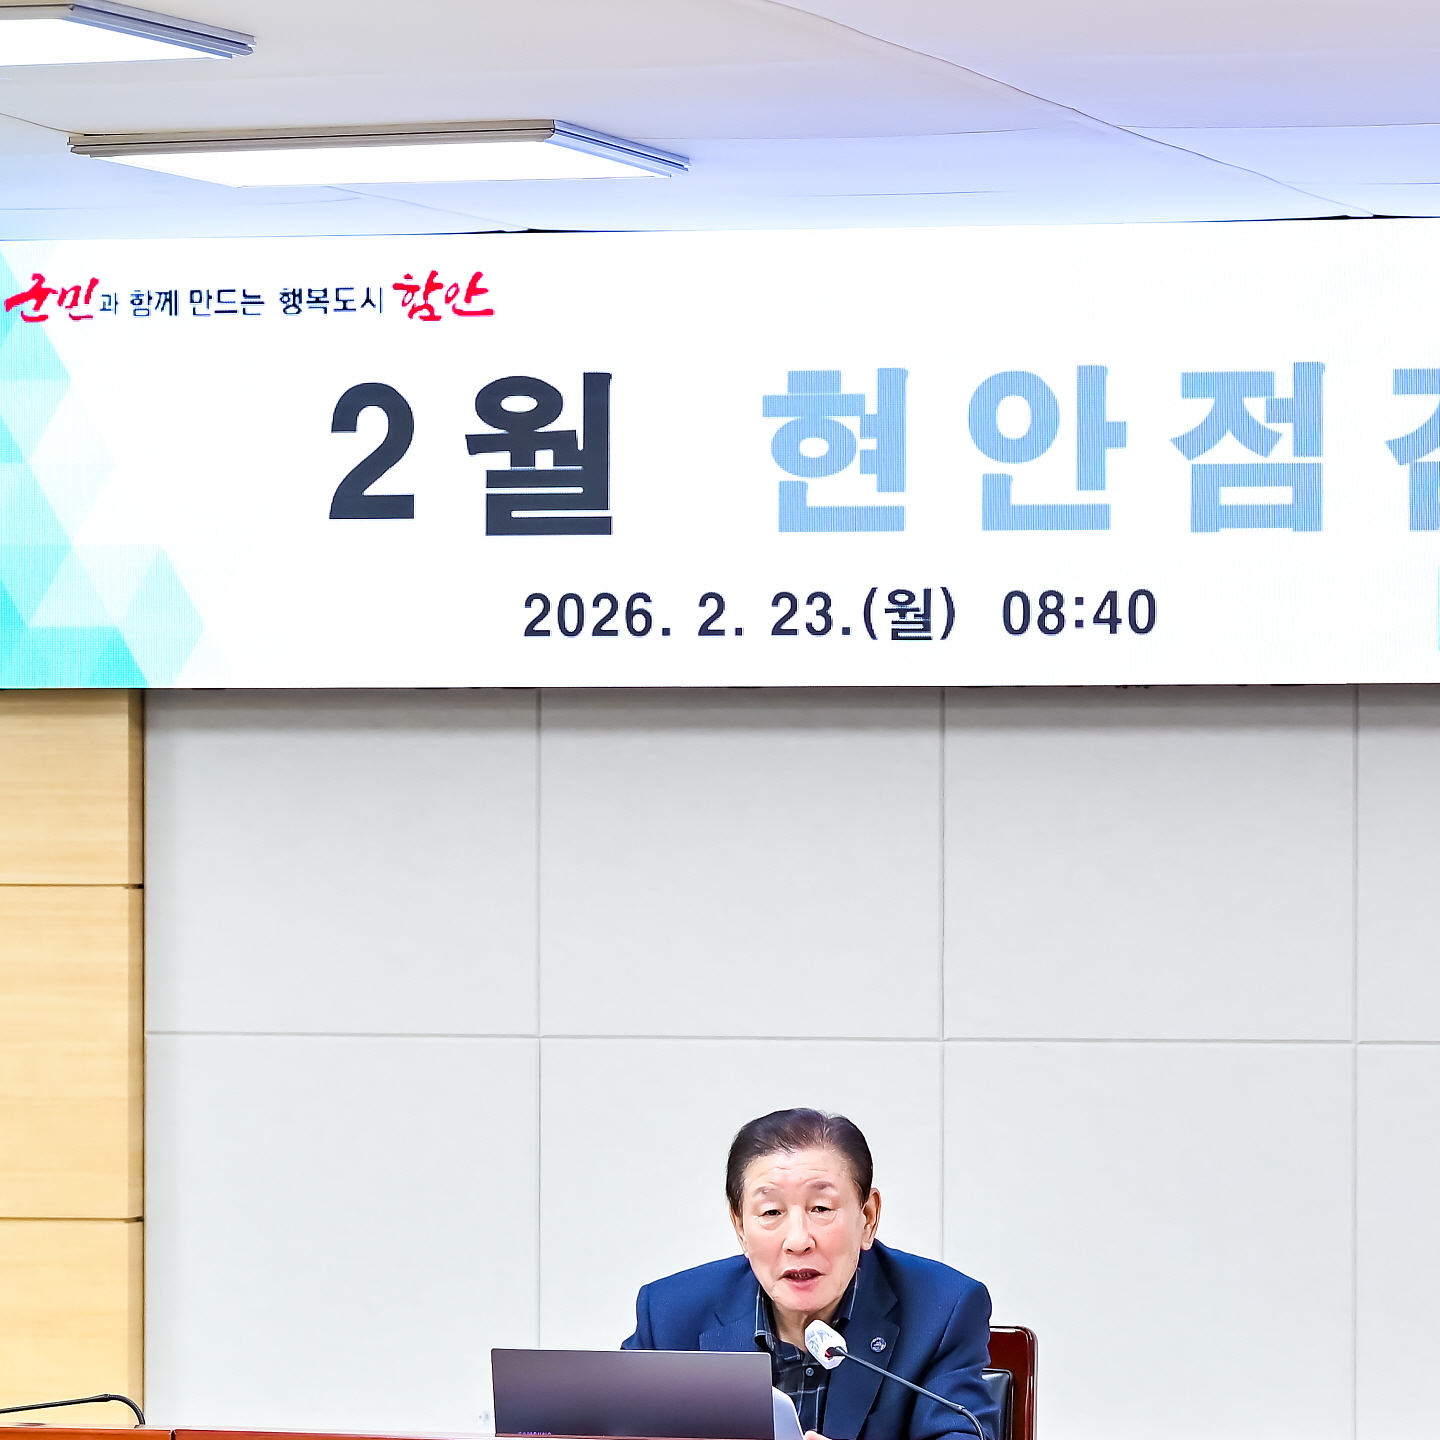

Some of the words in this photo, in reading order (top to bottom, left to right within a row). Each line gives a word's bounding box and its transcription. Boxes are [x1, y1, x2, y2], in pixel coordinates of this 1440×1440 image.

[129, 289, 178, 317] 함께
[188, 288, 266, 317] 만드는
[278, 287, 383, 316] 행복도시
[393, 270, 495, 322] 함안
[329, 371, 613, 537] 2월
[523, 591, 671, 637] 2026.
[697, 591, 743, 637] 2.
[771, 586, 957, 641] 23.(월)
[1002, 588, 1156, 637] 08:40
